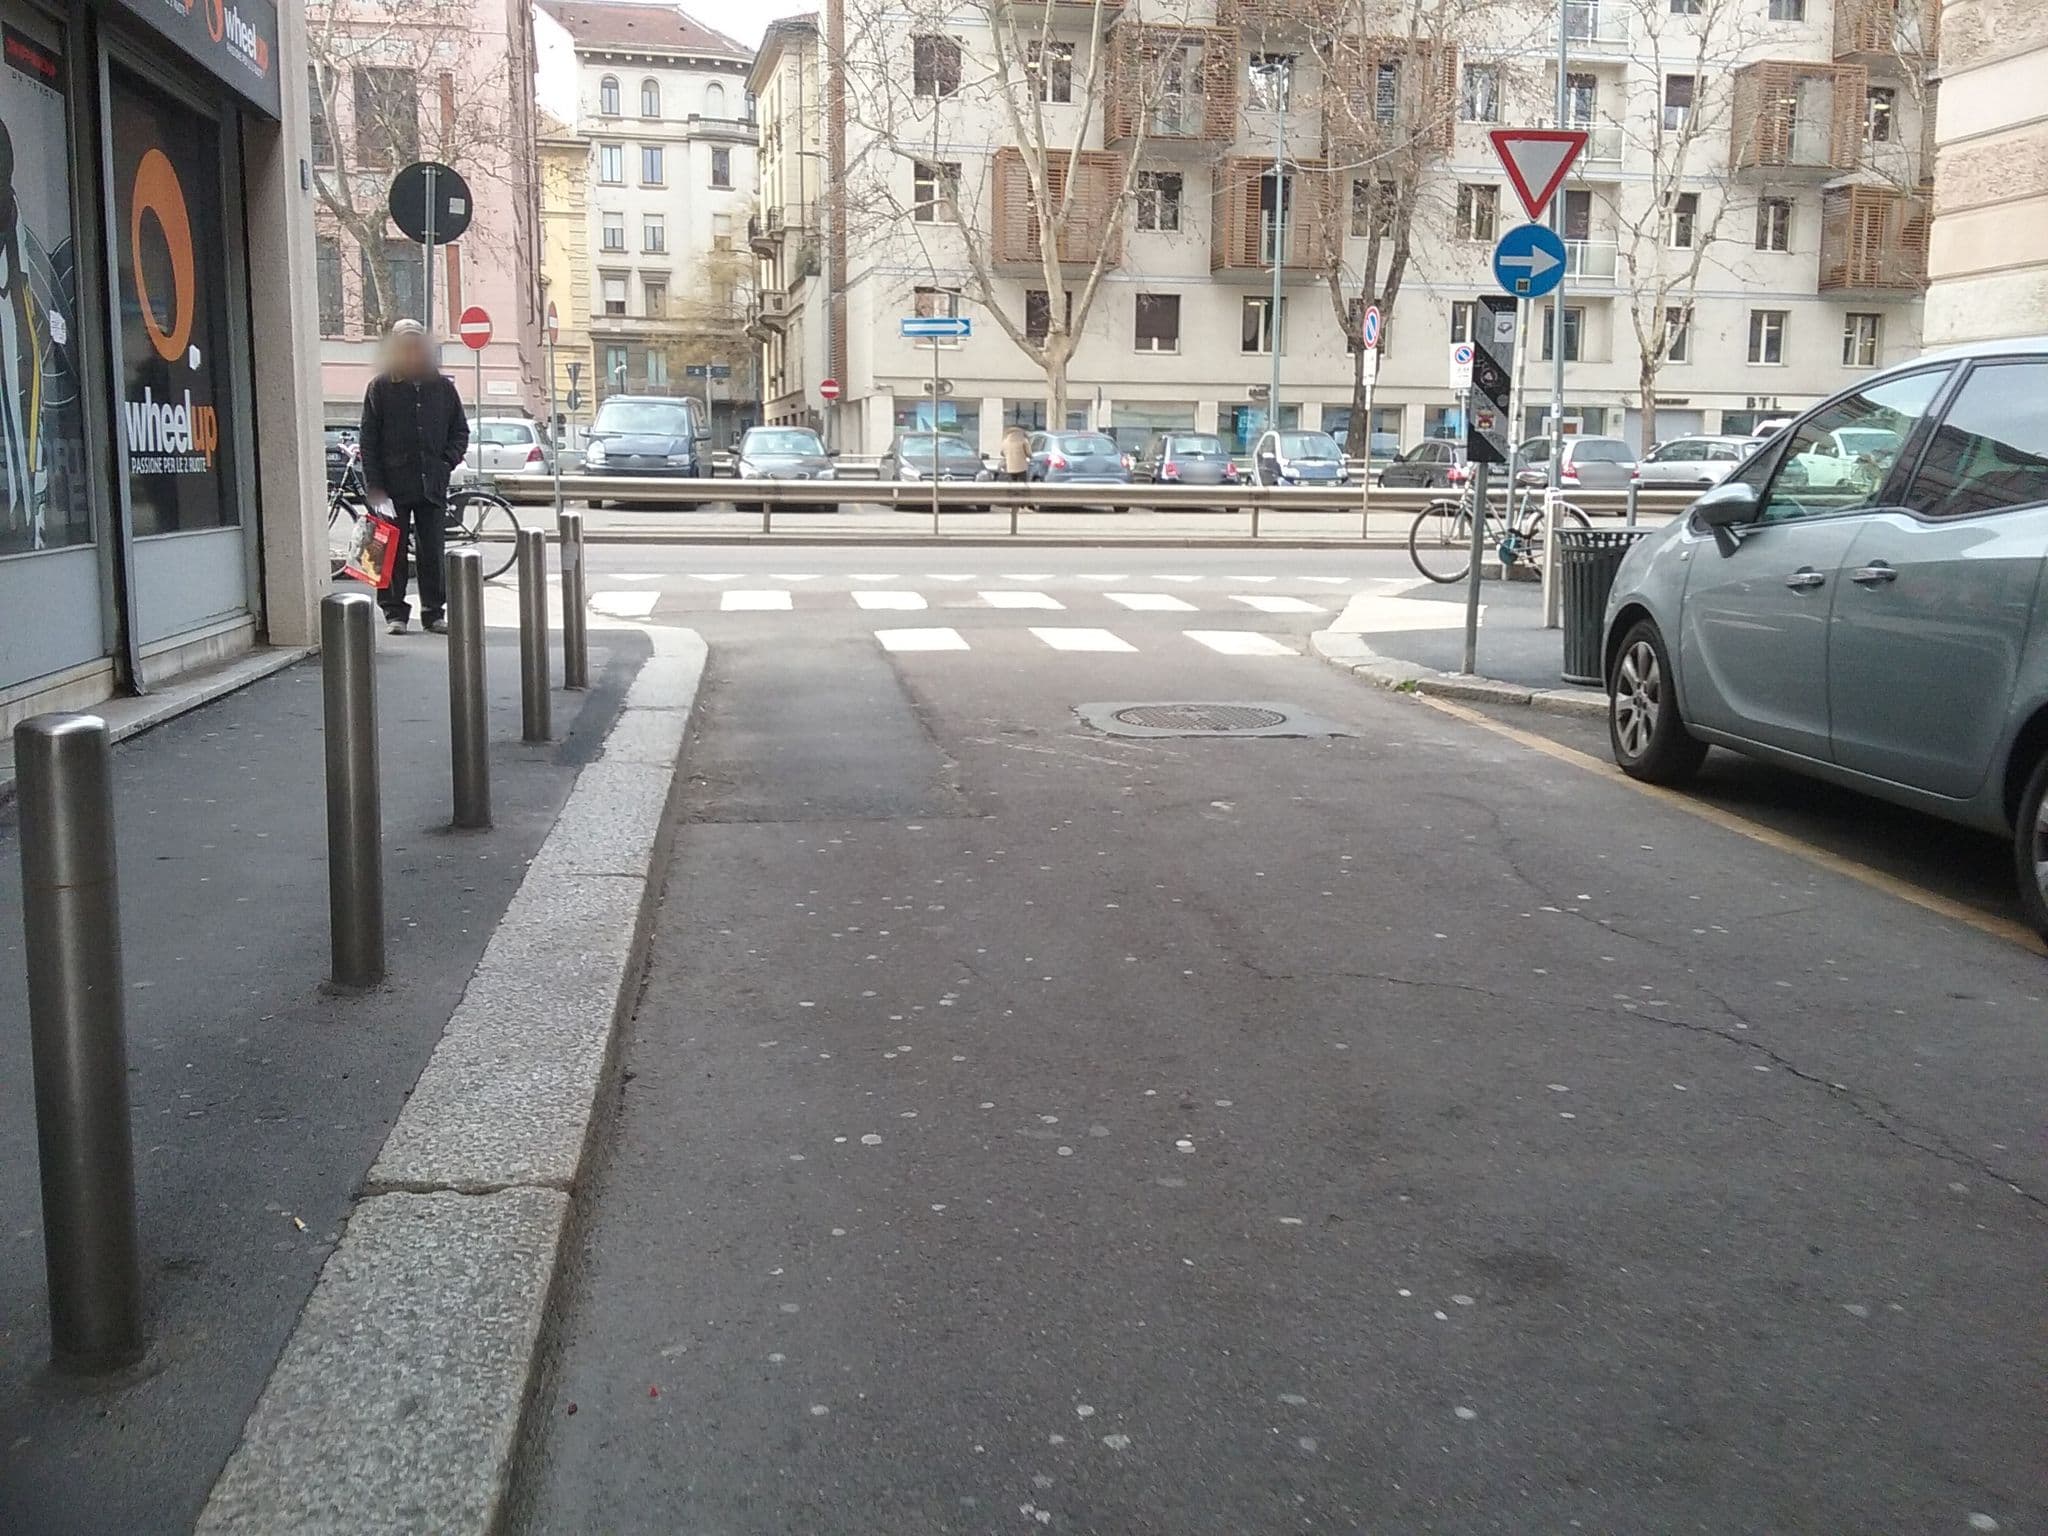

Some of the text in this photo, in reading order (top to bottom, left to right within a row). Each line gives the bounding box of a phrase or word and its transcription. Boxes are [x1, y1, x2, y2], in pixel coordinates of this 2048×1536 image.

[1745, 396, 1782, 410] BTL
[124, 386, 217, 467] wheelup
[131, 457, 207, 474] PASSIONE PER LE 2 RUOTE
